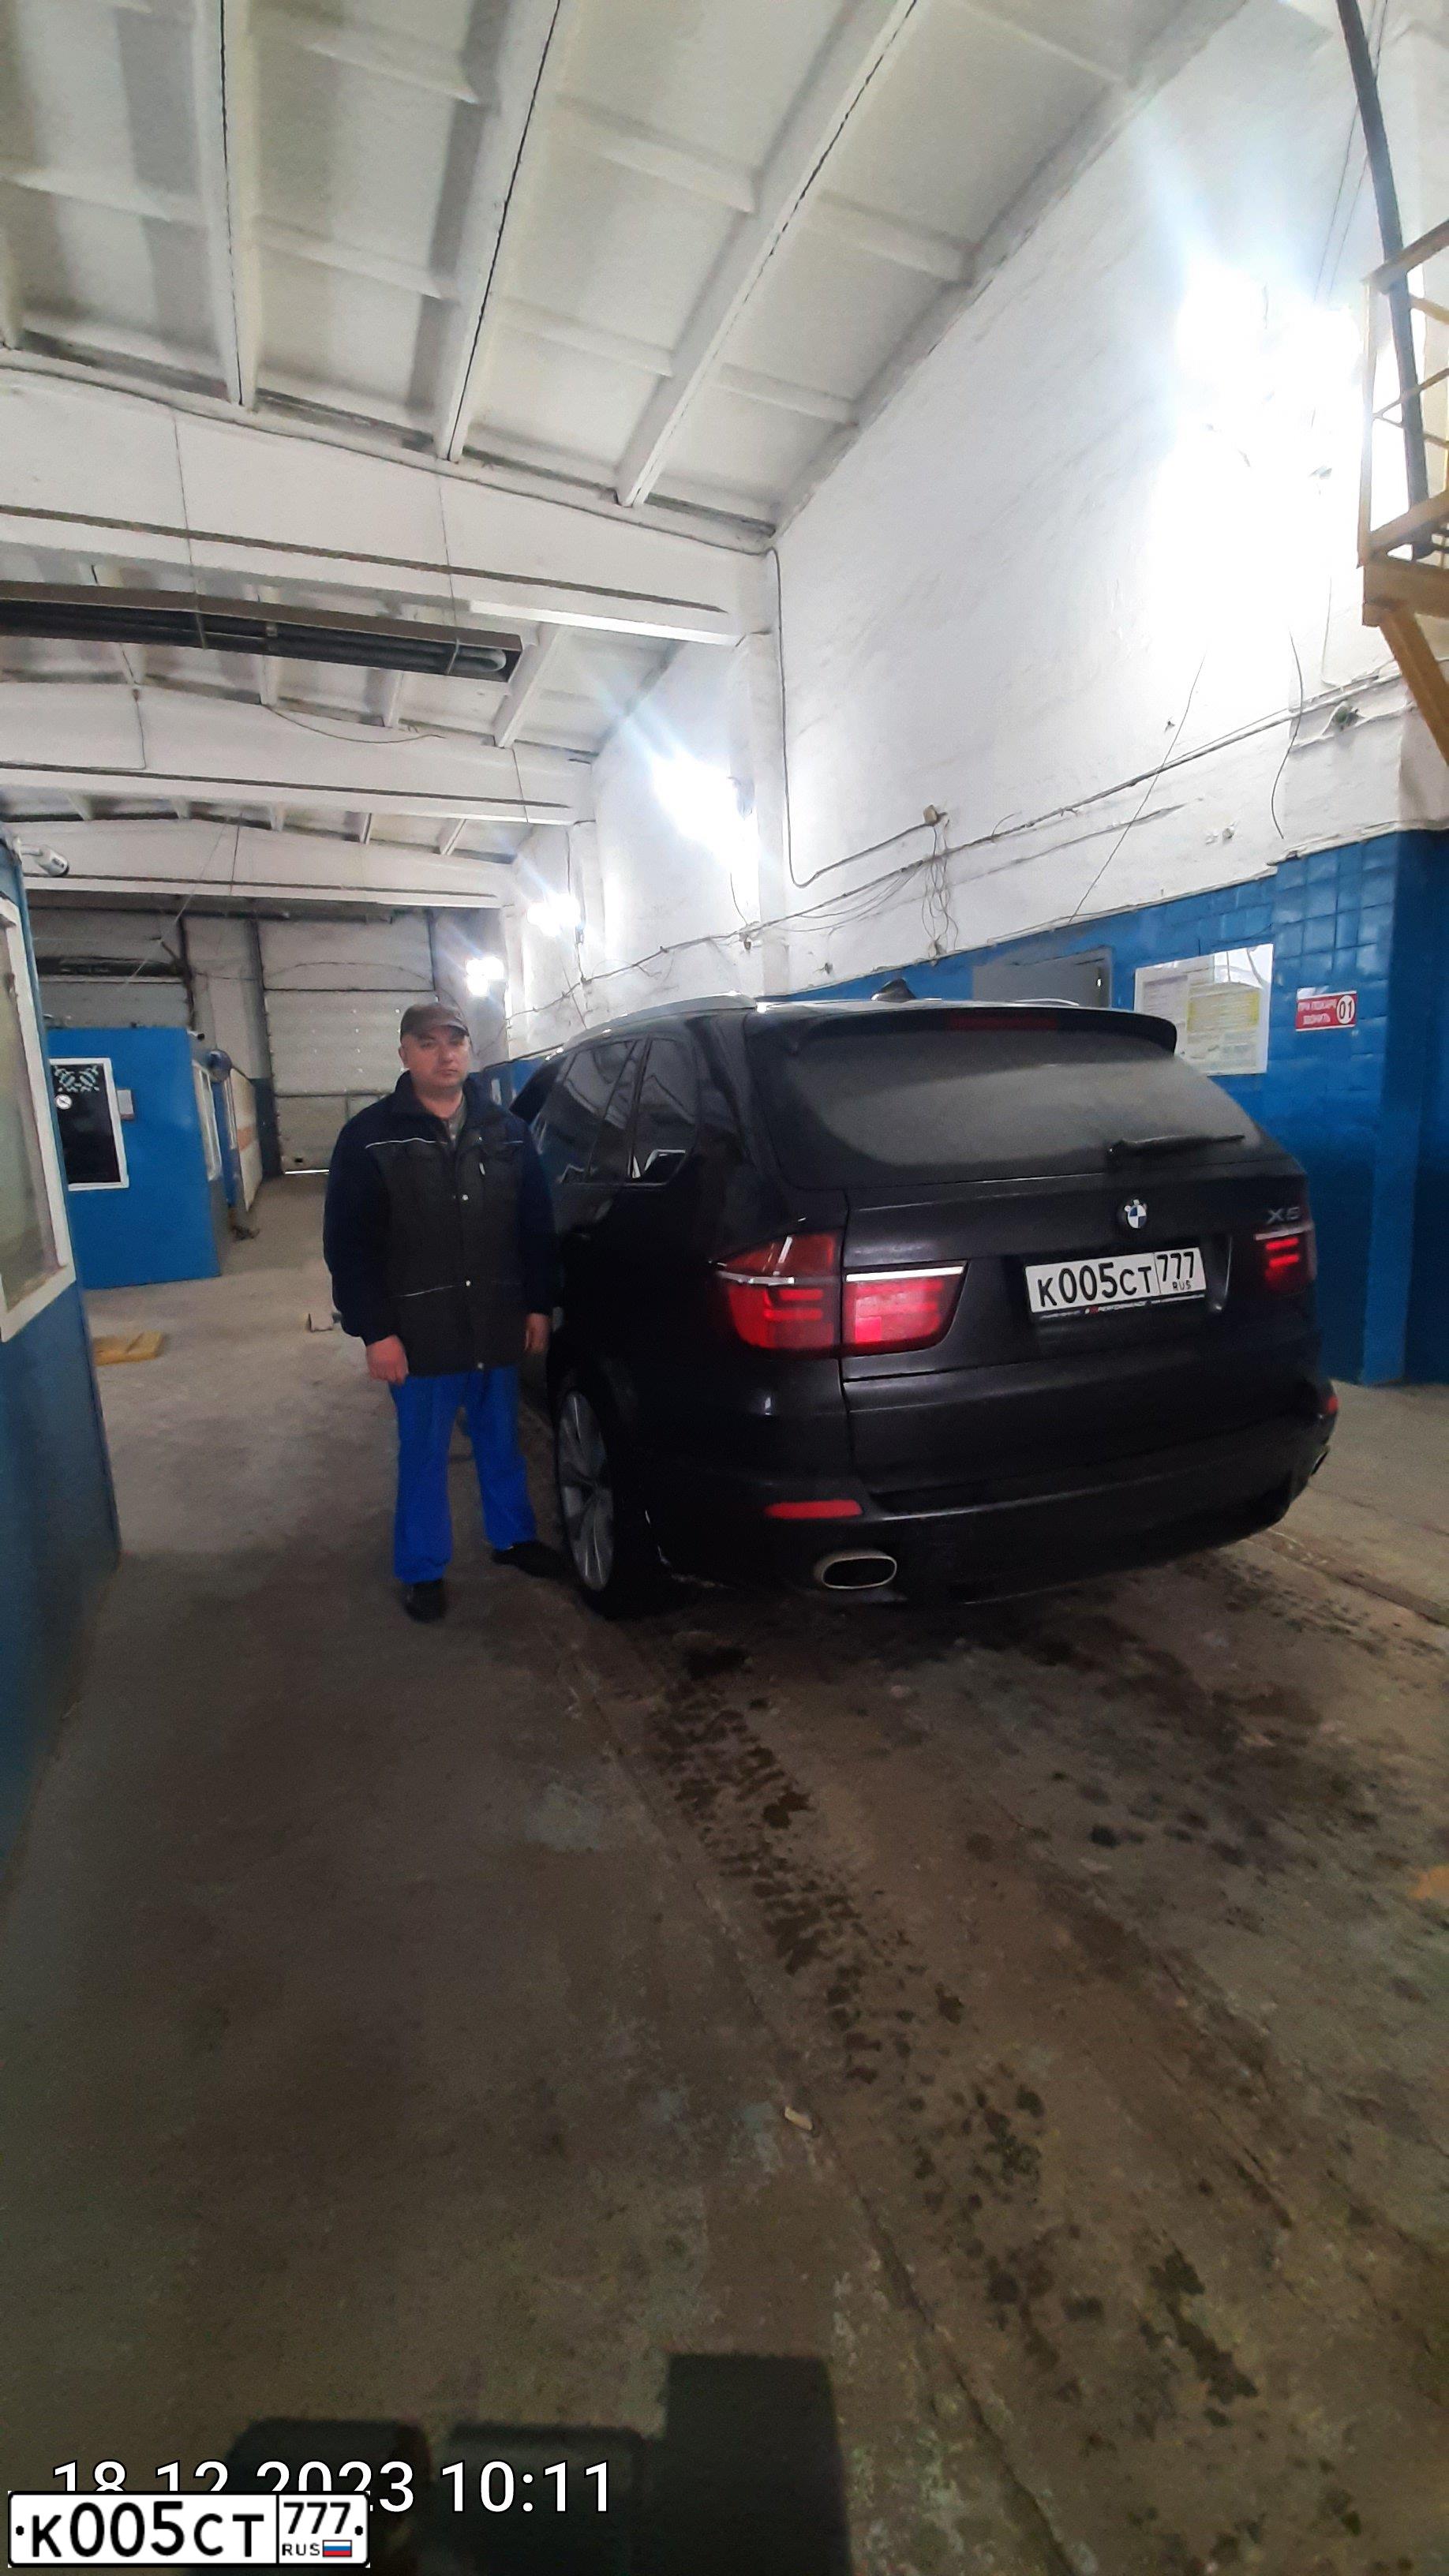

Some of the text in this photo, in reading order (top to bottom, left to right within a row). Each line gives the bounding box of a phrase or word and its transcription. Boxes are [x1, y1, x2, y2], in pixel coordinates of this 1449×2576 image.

[1339, 1000, 1353, 1019] 01
[1157, 1252, 1194, 1282] 777
[1172, 1279, 1192, 1290] RUS
